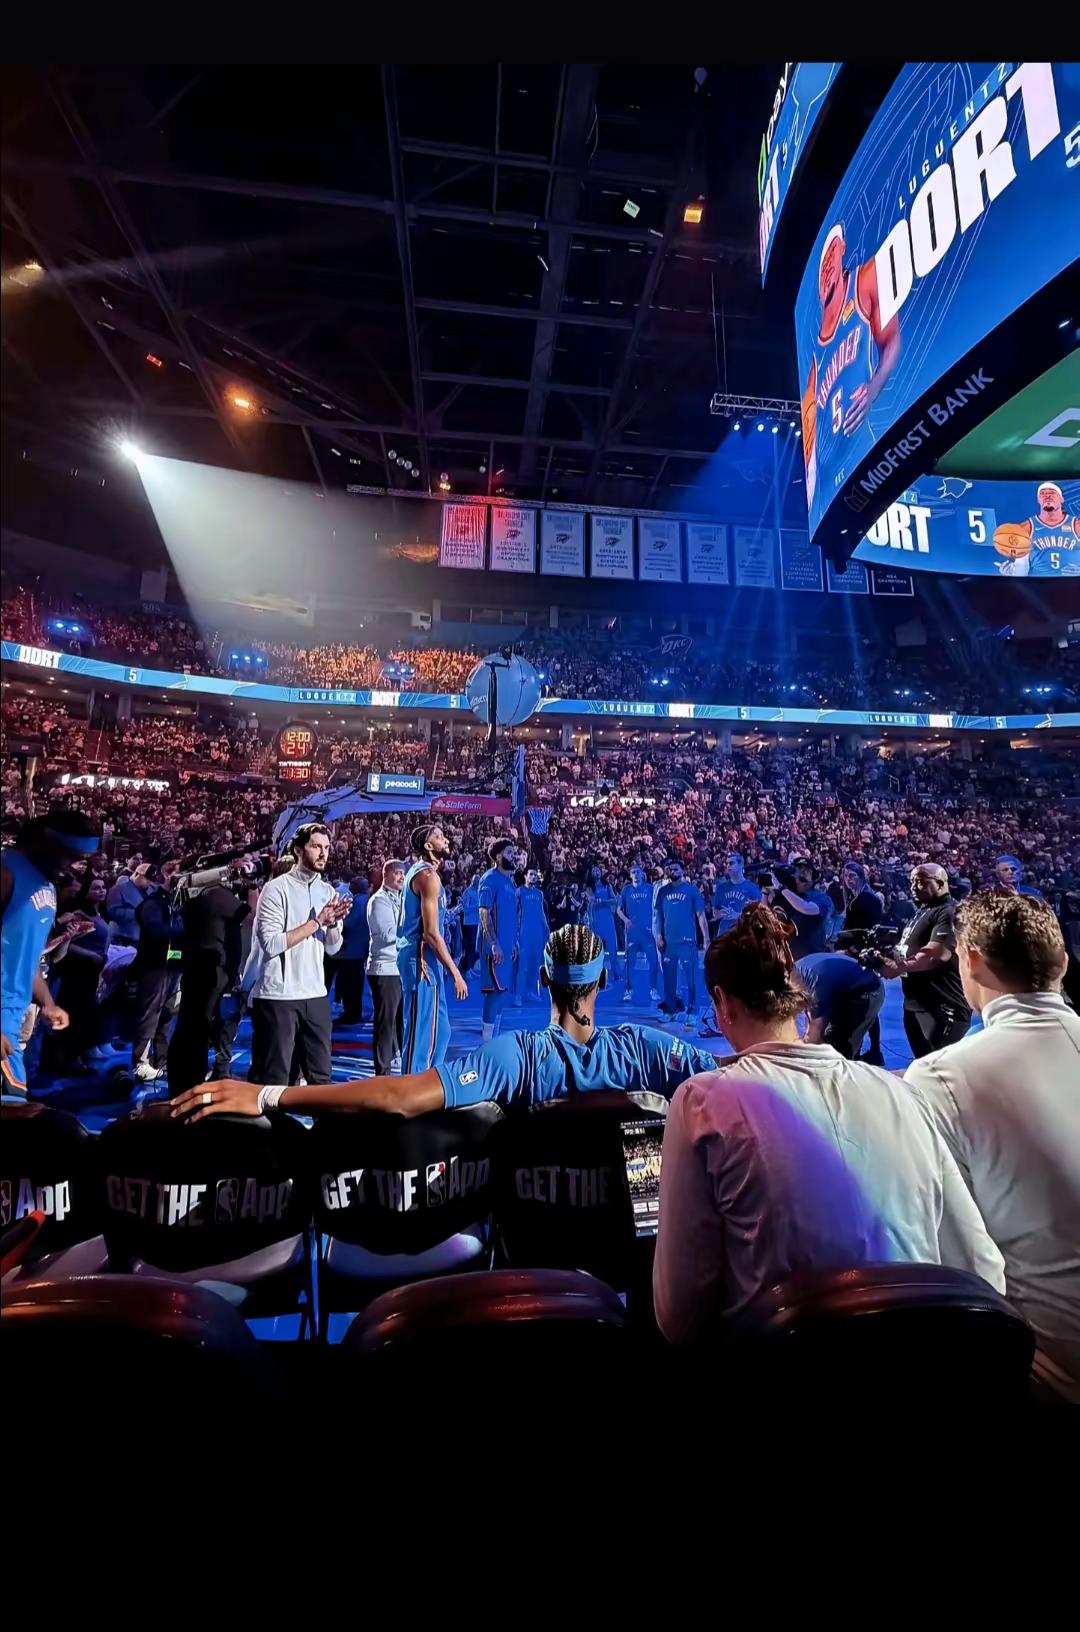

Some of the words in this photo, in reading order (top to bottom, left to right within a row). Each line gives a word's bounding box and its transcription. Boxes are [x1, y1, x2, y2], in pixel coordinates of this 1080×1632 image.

[874, 62, 1061, 330] DORT
[816, 326, 861, 410] THUNDER
[832, 384, 842, 434] 5
[968, 509, 986, 544] 5
[1033, 535, 1077, 551] THUNDER
[1050, 552, 1060, 570] 5
[129, 669, 138, 682] 5
[450, 695, 458, 708] 5
[741, 706, 748, 719] 5
[996, 715, 1004, 728] 5
[287, 732, 310, 742] 12:00
[287, 742, 306, 754] 24
[320, 1168, 368, 1211] GET
[371, 1169, 420, 1212] THE
[156, 1184, 207, 1227] THE
